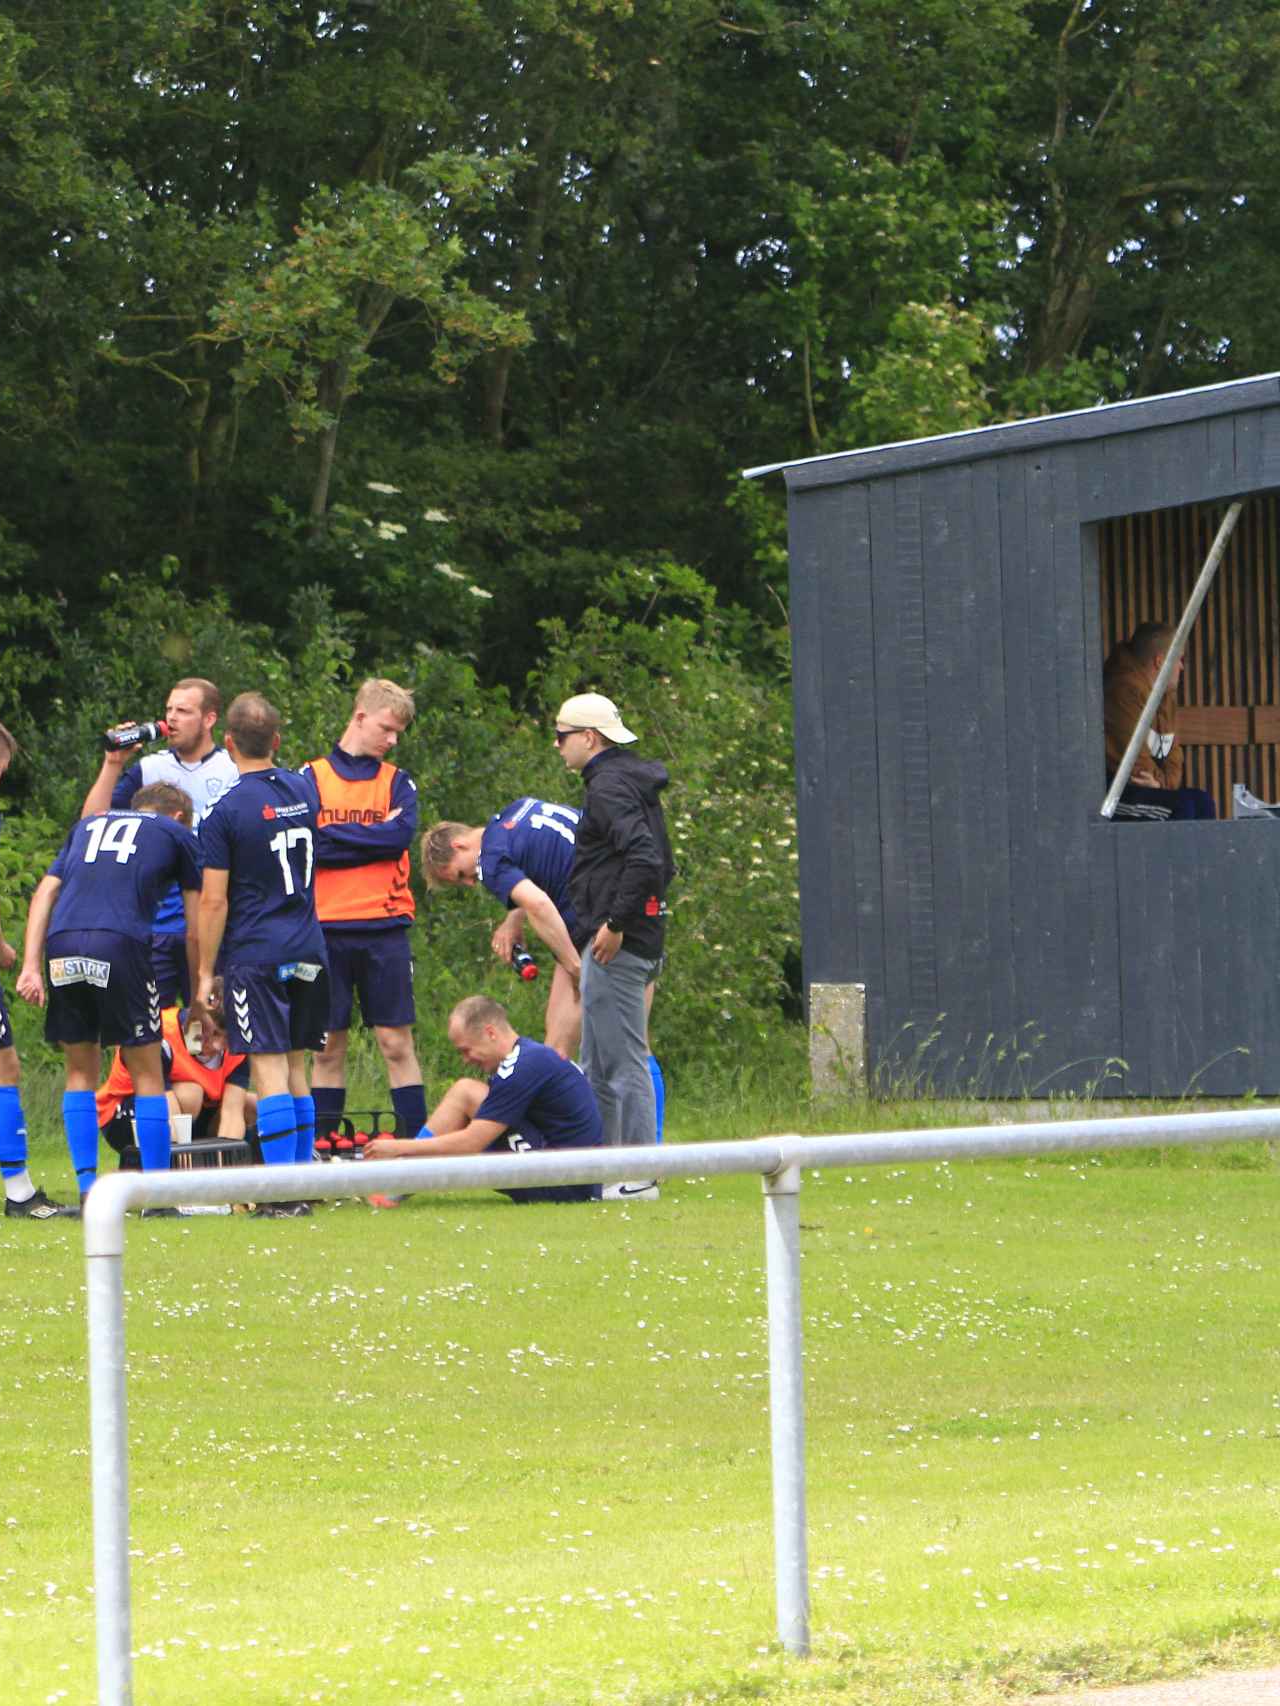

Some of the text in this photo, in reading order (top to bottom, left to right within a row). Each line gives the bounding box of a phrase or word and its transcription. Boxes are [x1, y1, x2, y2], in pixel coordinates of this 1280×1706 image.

[321, 808, 386, 824] humme
[530, 802, 579, 845] 11
[84, 817, 142, 864] 14
[270, 827, 313, 895] 17
